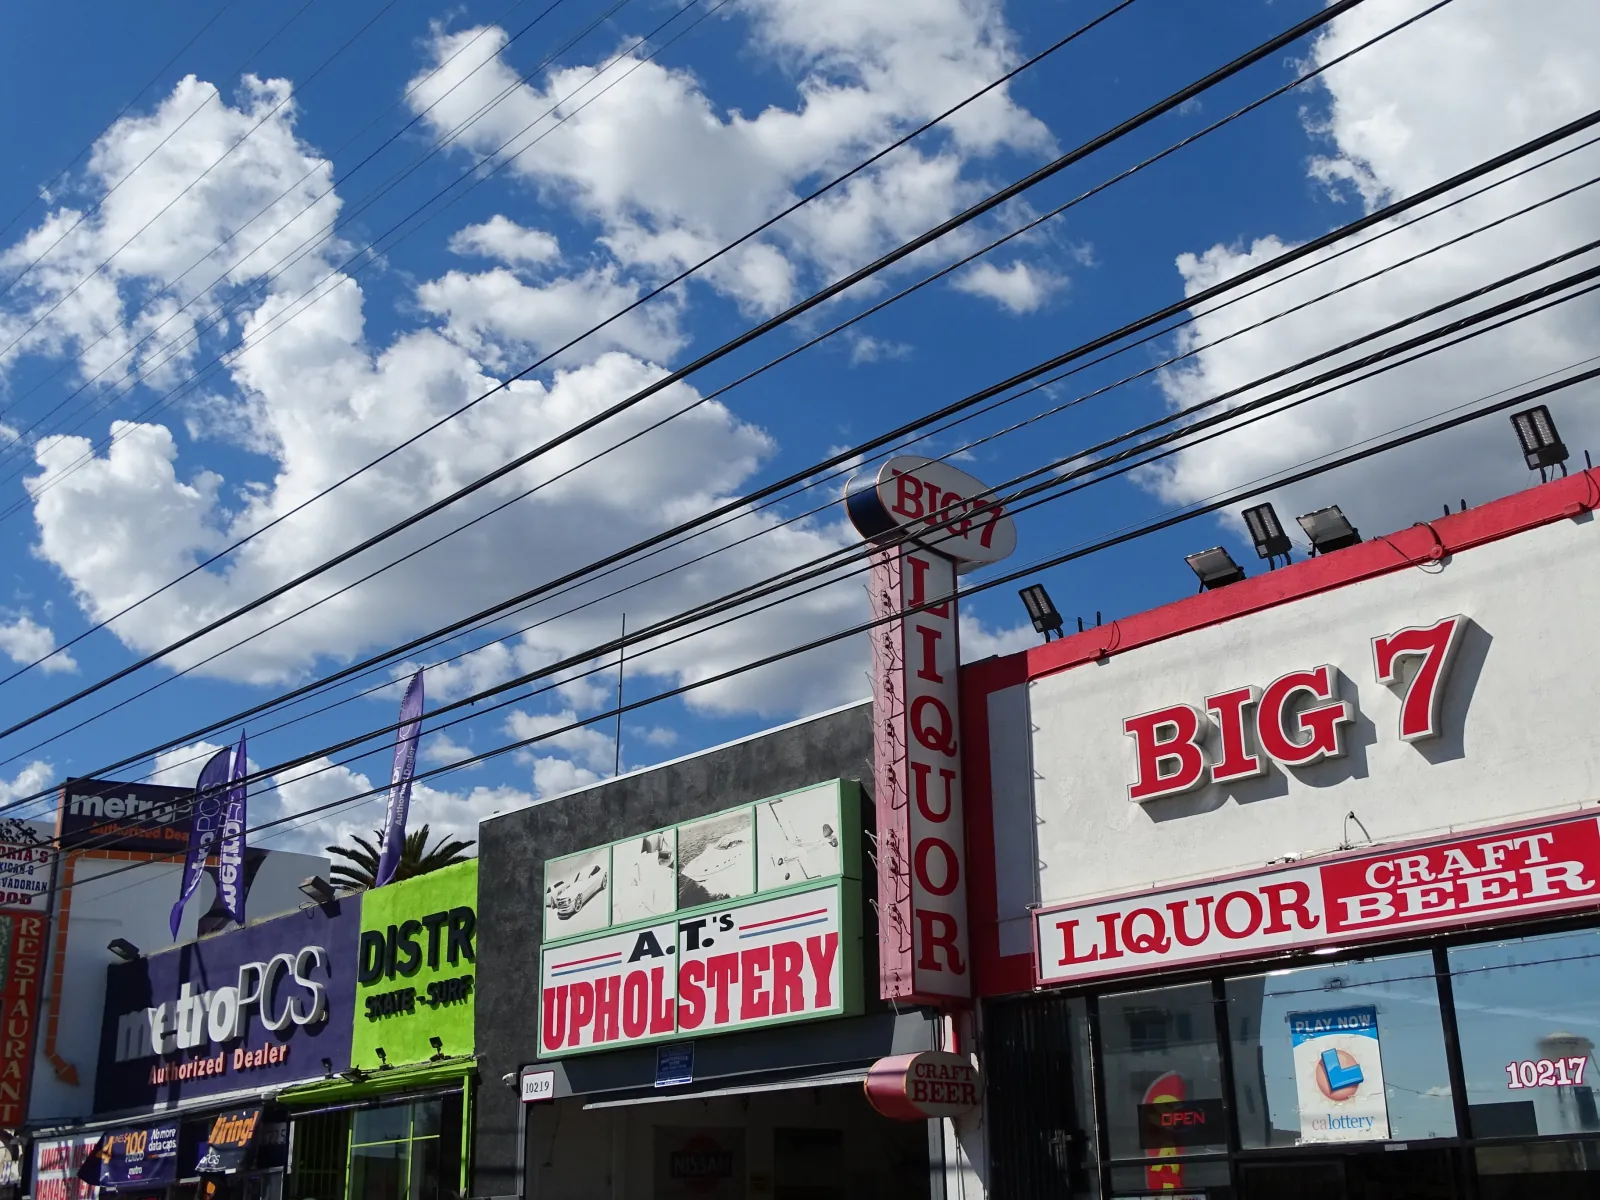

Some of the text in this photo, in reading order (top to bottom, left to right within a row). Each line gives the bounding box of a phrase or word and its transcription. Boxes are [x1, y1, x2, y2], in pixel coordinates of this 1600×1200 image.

[892, 469, 1004, 549] BIG 7
[1123, 613, 1468, 802] BIG 7
[904, 555, 966, 978] LIQUOR
[69, 793, 193, 823] metroP
[164, 829, 191, 841] Dea
[1366, 832, 1554, 889] CRAFT
[1338, 860, 1598, 928] BEER
[1056, 881, 1320, 967] LIQUOR
[358, 906, 476, 987] DISTR
[115, 945, 326, 1063] metroPCS
[543, 931, 839, 1051] UPHOLSTERY
[0, 917, 42, 1122] RESTAURANT
[1295, 1014, 1371, 1034] PLAY NOW
[149, 1042, 287, 1084] Authorized Dealer
[915, 1063, 973, 1082] CRAFT
[1506, 1056, 1587, 1089] 10217
[525, 1080, 550, 1094] 10219
[911, 1080, 978, 1105] BEER
[159, 1128, 176, 1139] more
[1160, 1111, 1206, 1127] OPEN
[1312, 1113, 1375, 1131] calottery
[148, 1140, 162, 1152] data
